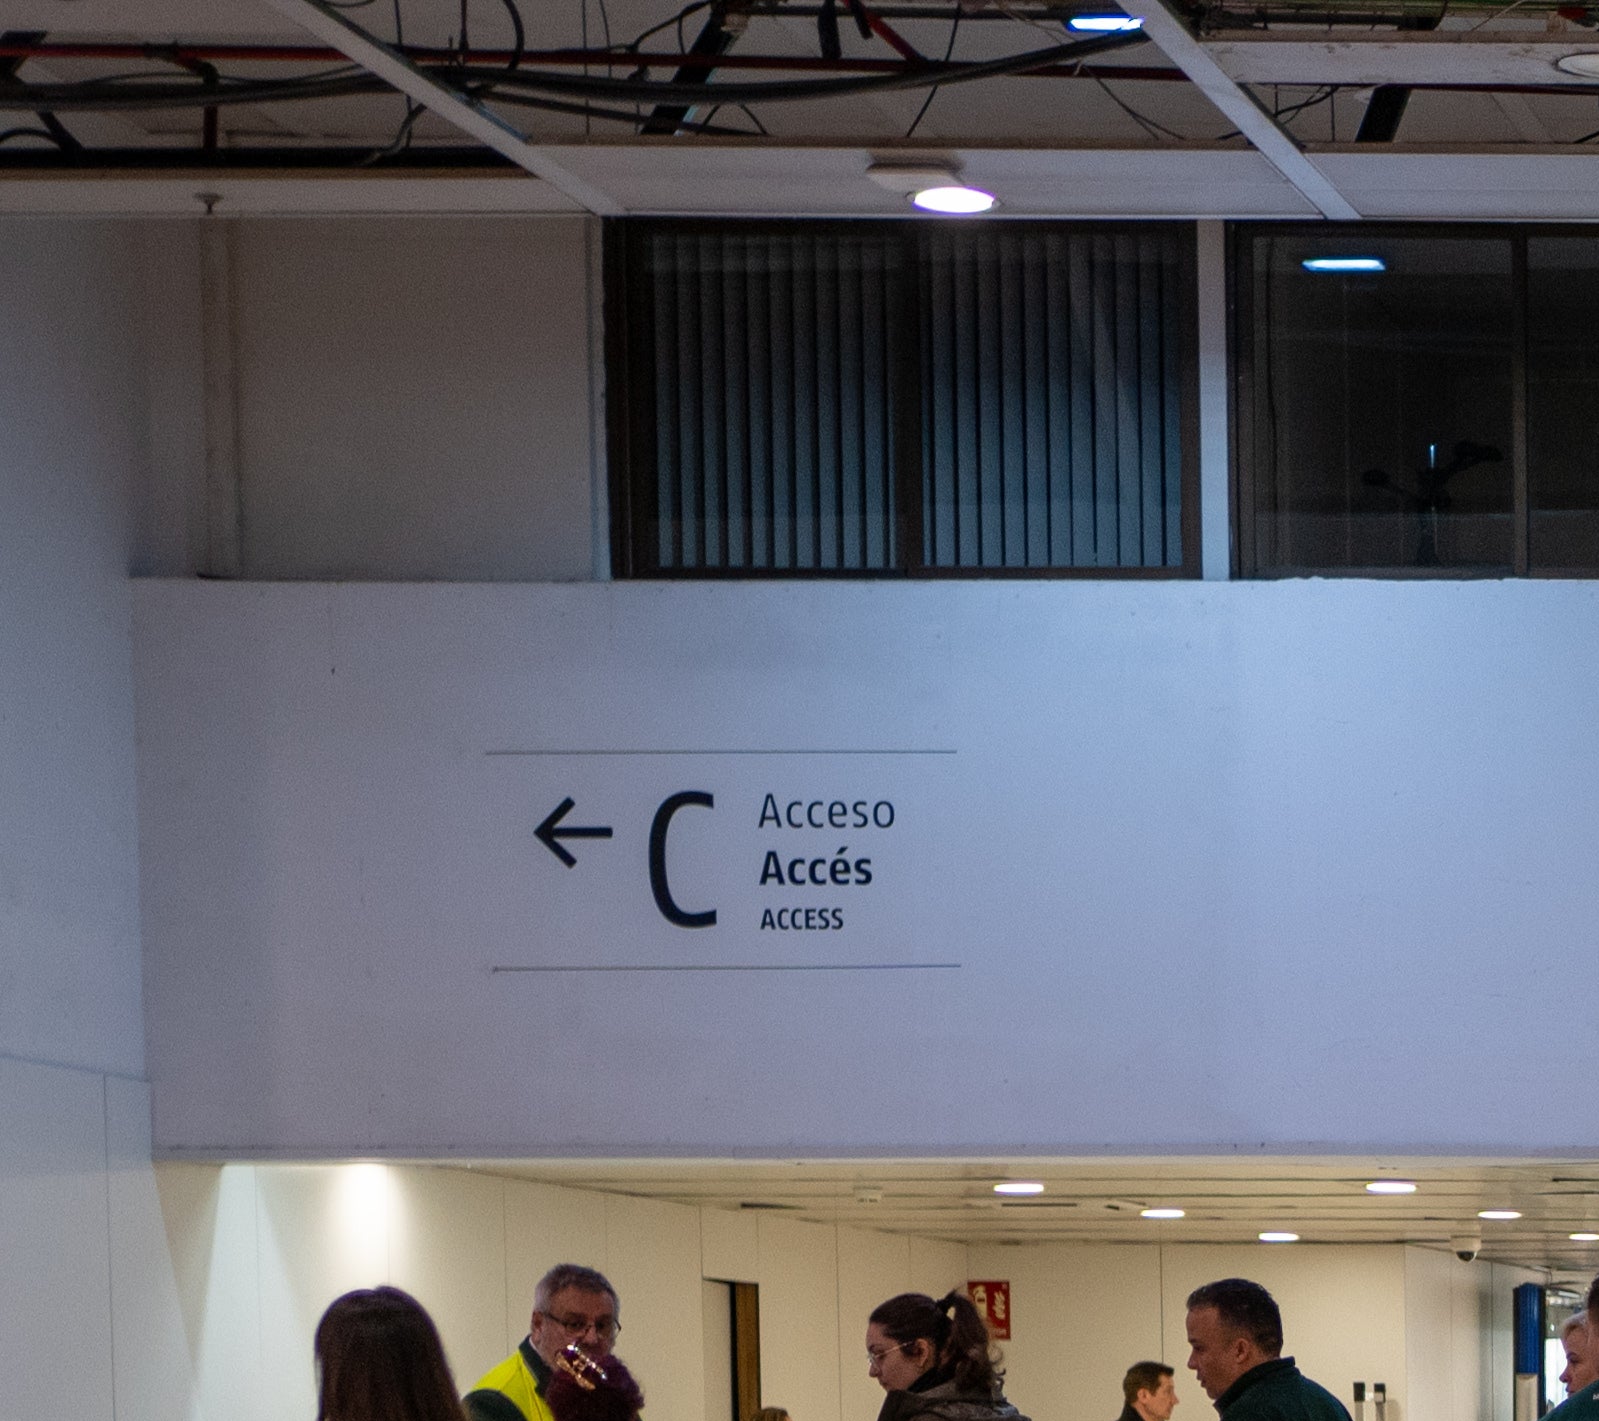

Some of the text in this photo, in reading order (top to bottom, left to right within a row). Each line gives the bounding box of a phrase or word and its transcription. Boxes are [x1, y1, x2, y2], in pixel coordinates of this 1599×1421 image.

[758, 792, 896, 829] Acceso
[648, 790, 718, 929] C
[759, 846, 873, 886] Accés
[760, 907, 844, 931] ACCESS
